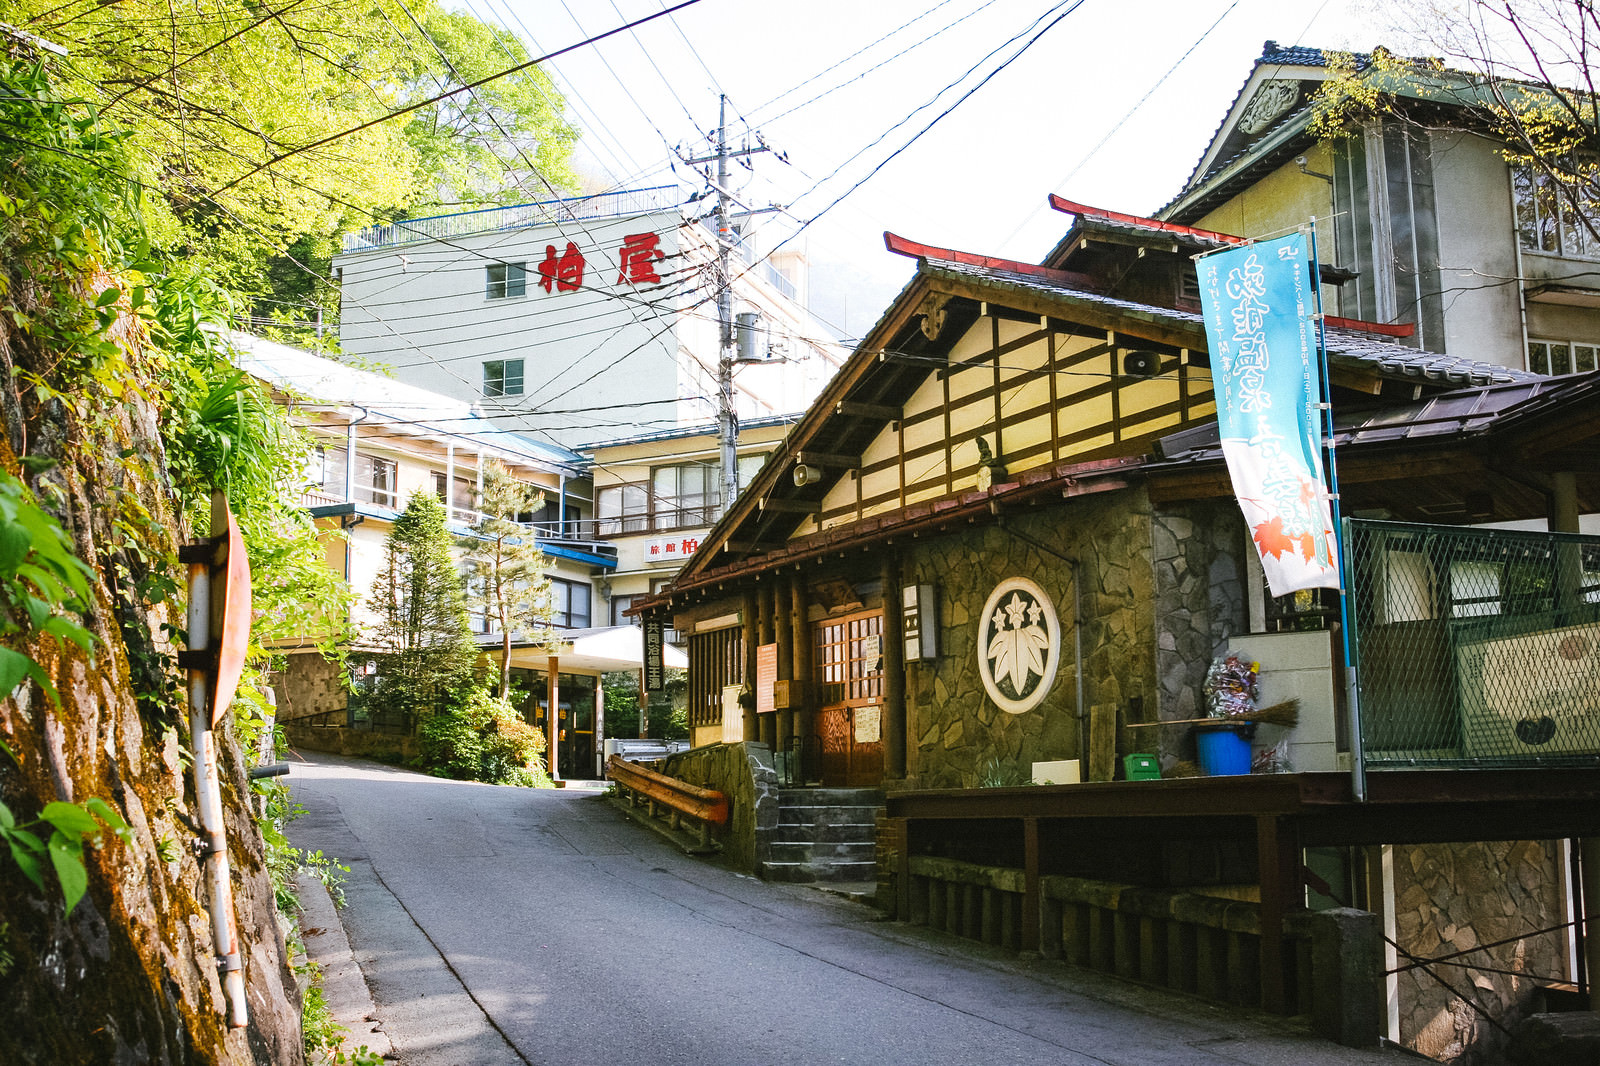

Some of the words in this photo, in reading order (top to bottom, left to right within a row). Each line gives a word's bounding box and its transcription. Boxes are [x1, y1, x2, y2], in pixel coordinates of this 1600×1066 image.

[538, 233, 665, 294] 柏屋
[647, 622, 661, 689] 共同浴場王湯
